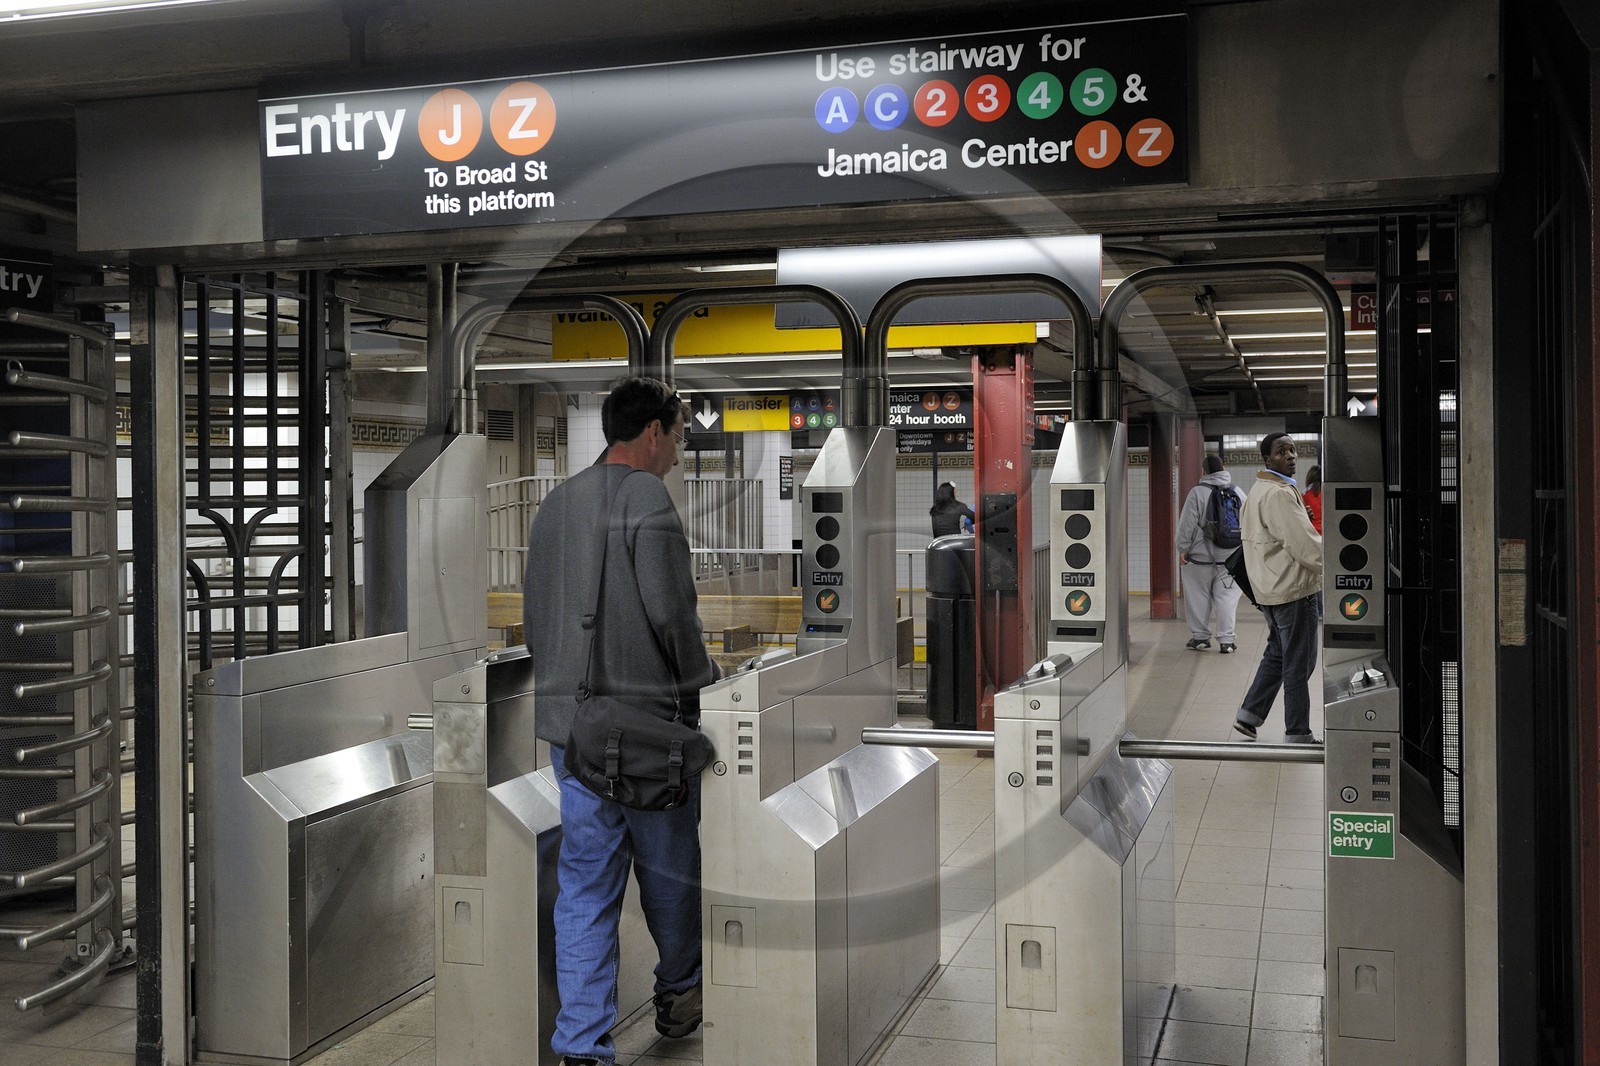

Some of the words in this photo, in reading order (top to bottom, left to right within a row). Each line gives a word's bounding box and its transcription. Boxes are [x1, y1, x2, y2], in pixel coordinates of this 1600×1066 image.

[814, 53, 875, 82] Use
[889, 43, 1024, 76] stairway
[1039, 33, 1087, 62] for
[825, 96, 849, 124] A
[874, 92, 899, 122] C
[926, 88, 947, 117] 2
[976, 83, 999, 113] 3
[1028, 81, 1051, 110] 4
[1081, 77, 1105, 107] 5
[1122, 73, 1148, 103] &
[265, 102, 407, 160] Entry
[438, 104, 462, 146] J
[507, 97, 539, 140] Z
[817, 144, 947, 178] Jamaica
[961, 137, 1073, 169] Center
[1087, 129, 1108, 159] J
[1137, 127, 1162, 158] Z
[424, 167, 448, 187] To
[456, 162, 516, 186] Broad
[524, 160, 548, 182] St
[425, 193, 461, 215] this
[468, 189, 555, 216] platform
[725, 396, 783, 411] Transfer
[794, 400, 801, 409] A
[810, 399, 817, 408] C
[827, 399, 833, 408] 2
[928, 395, 935, 407] J
[946, 395, 956, 406] Z
[794, 415, 802, 425] 3
[810, 415, 817, 425] 4
[826, 415, 833, 425] 5
[889, 414, 902, 425] 24
[906, 414, 930, 425] hour
[934, 413, 966, 424] booth
[813, 572, 842, 585] Entry
[1062, 573, 1094, 586] Entry
[1336, 575, 1371, 589] Entry
[1332, 817, 1391, 834] Special
[1332, 834, 1373, 851] entry
